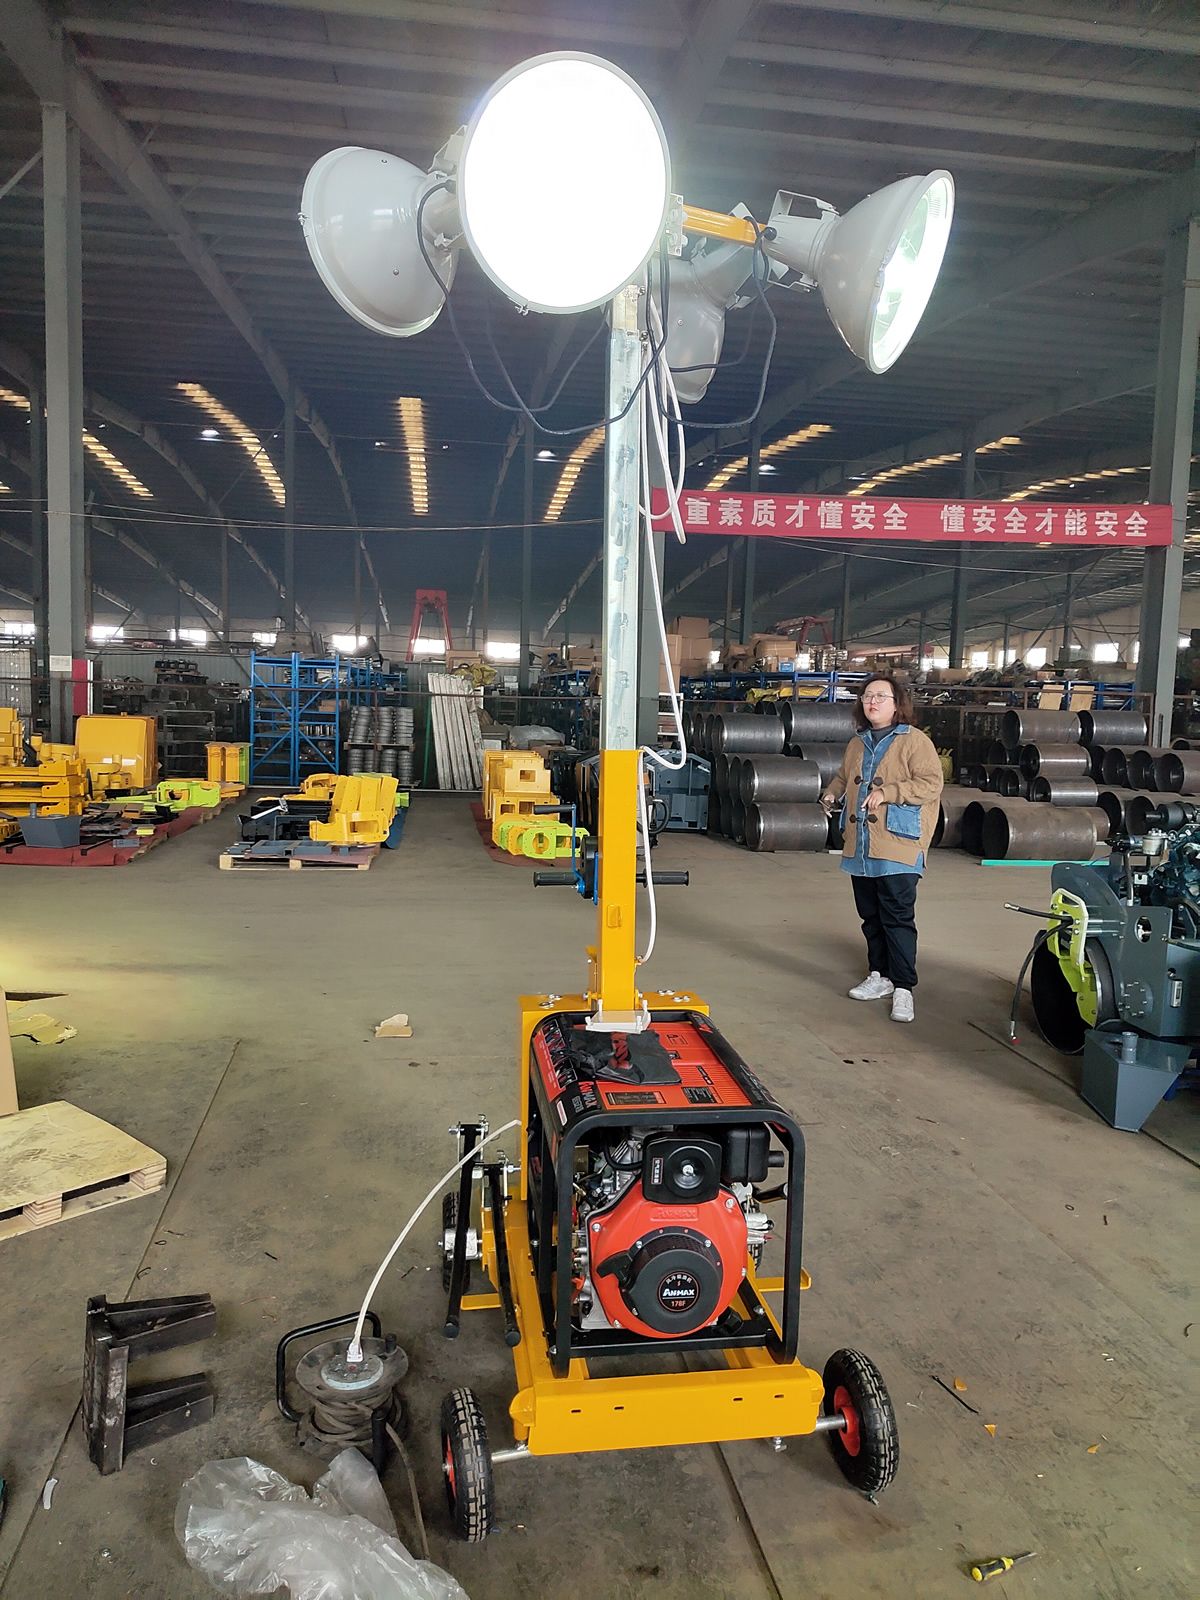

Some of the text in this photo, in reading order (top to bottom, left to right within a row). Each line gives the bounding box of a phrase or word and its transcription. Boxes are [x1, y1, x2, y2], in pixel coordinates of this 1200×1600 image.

[684, 497, 1149, 537] 重素质才懂安全 懂安全才能安全
